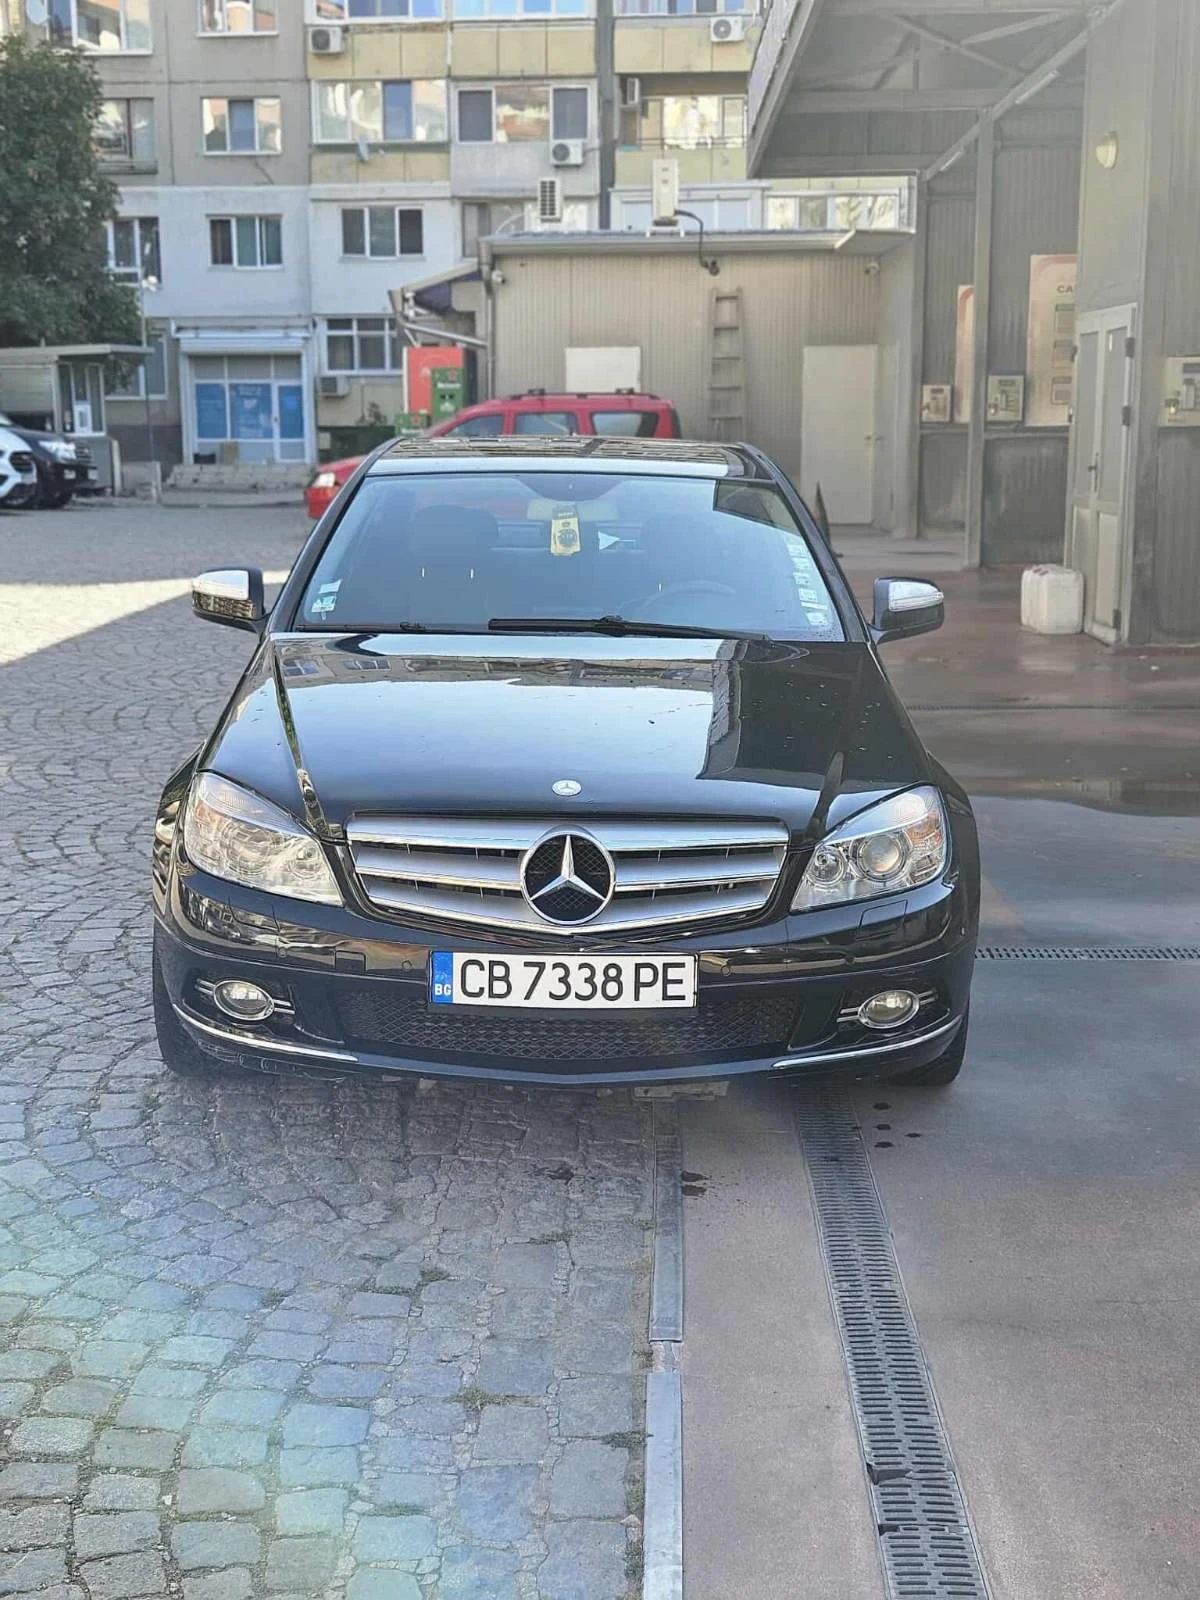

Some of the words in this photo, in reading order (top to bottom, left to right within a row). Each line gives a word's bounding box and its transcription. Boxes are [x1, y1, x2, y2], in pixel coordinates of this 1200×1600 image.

[434, 984, 452, 996] BG
[460, 959, 512, 999] CB
[523, 961, 623, 1001] 7338
[634, 962, 686, 1001] PE
